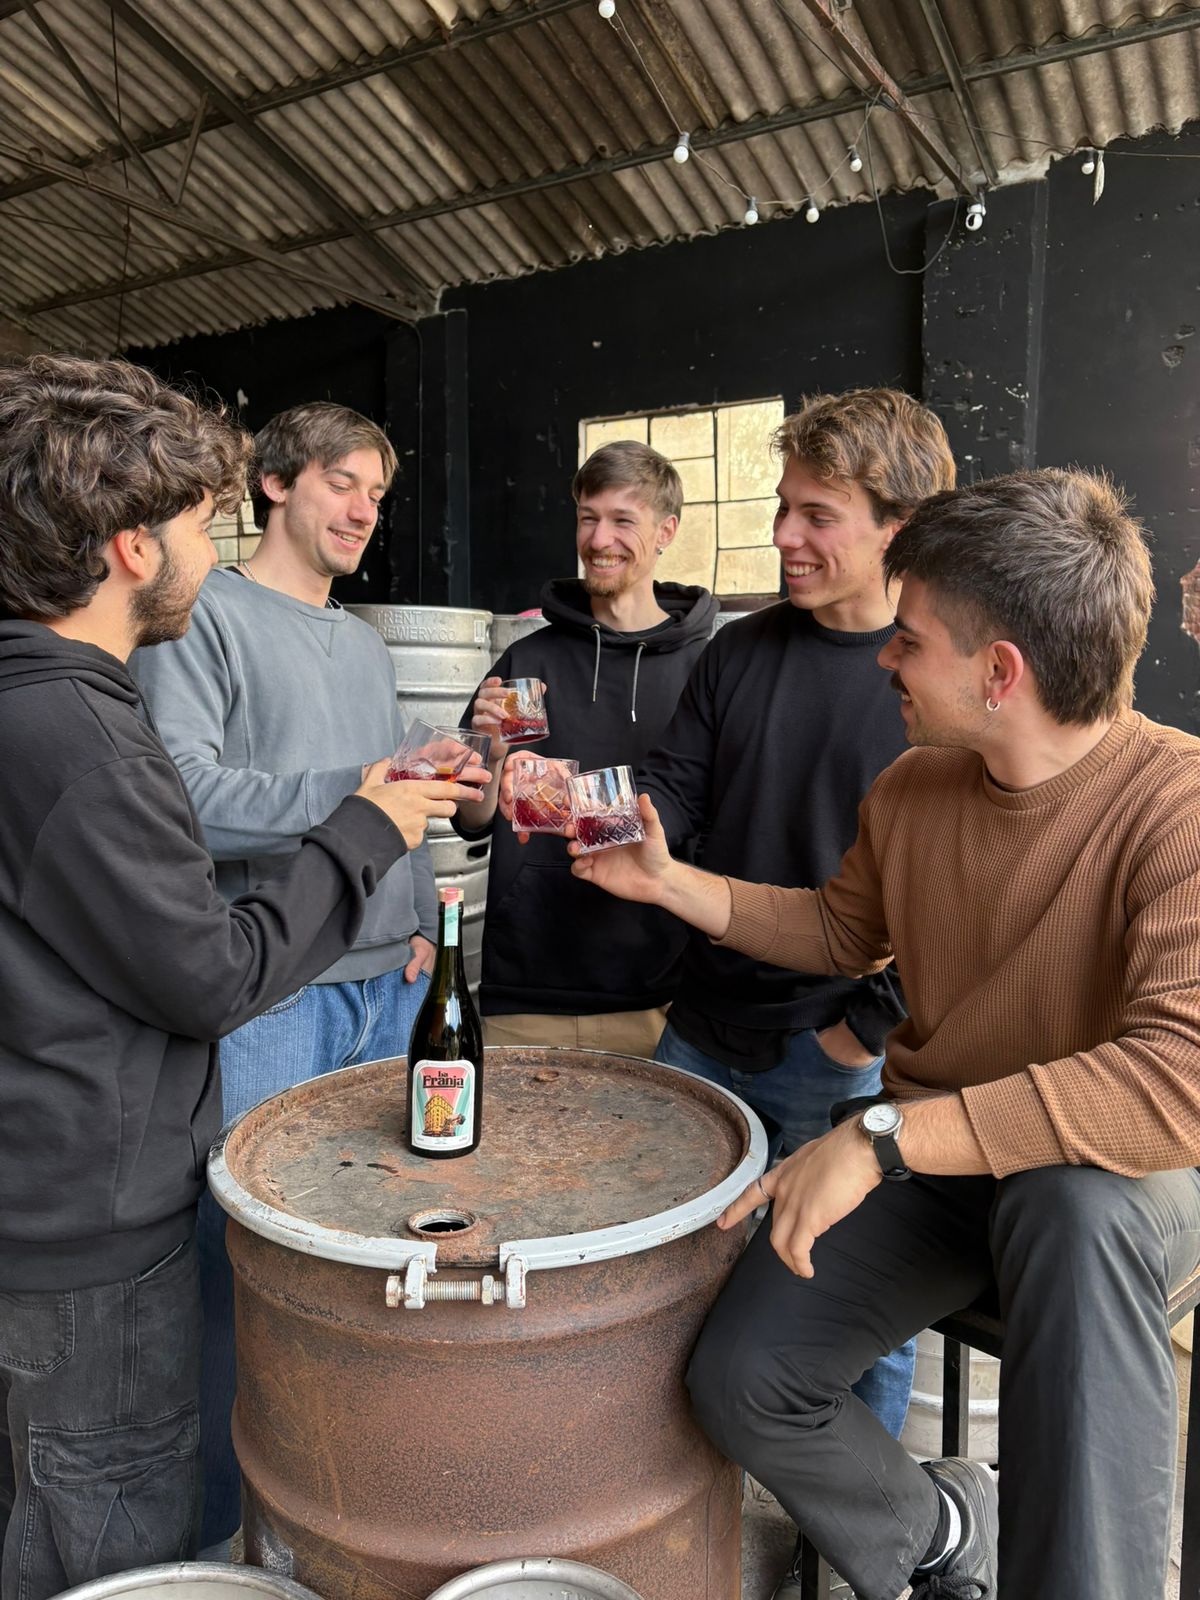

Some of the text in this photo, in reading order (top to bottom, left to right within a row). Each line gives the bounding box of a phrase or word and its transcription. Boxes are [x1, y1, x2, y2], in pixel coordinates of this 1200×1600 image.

[374, 610, 422, 625] TRENT
[375, 625, 435, 641] REWERY
[423, 1075, 464, 1088] Franja
